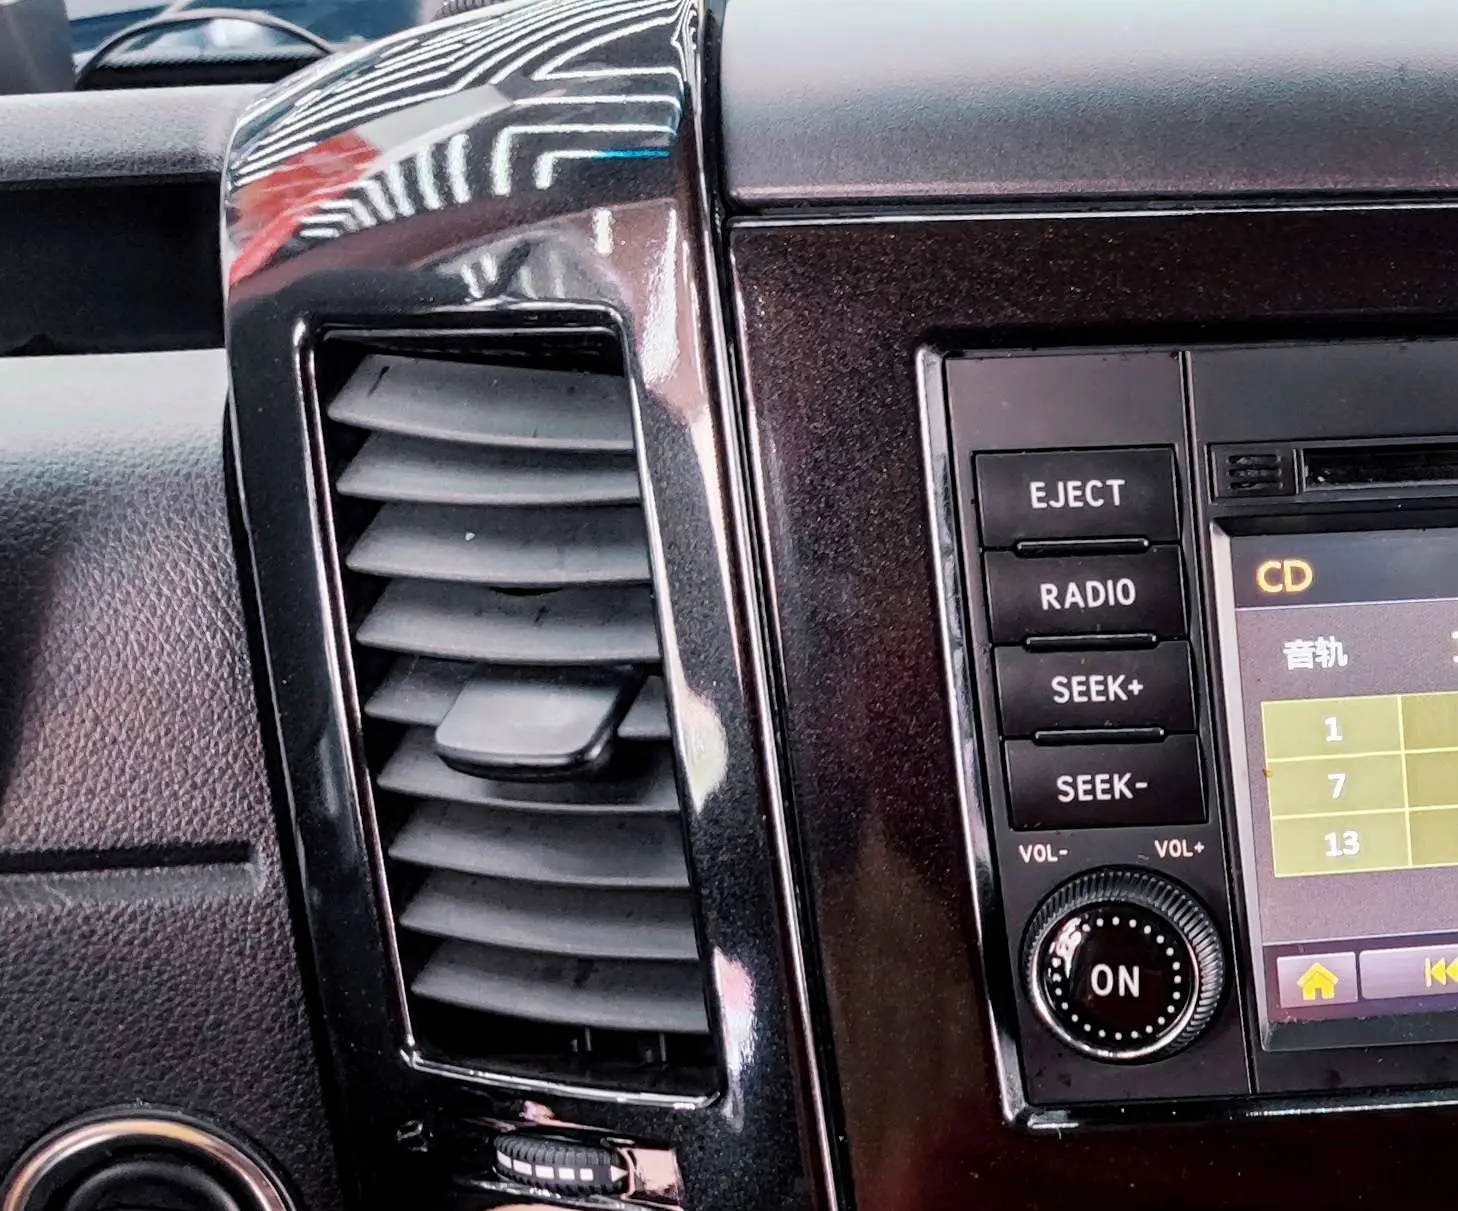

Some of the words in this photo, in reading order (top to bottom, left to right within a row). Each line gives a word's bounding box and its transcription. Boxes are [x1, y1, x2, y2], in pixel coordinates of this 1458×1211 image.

[1030, 479, 1125, 509] EJECT
[1256, 559, 1312, 594] CD
[1041, 579, 1136, 609] RADIO
[1283, 638, 1348, 670] 音轨
[1052, 675, 1144, 701] SEEK+
[1325, 718, 1341, 741] 1
[1056, 773, 1148, 802] SEEK-
[1328, 774, 1346, 798] 7
[1019, 844, 1068, 863] VOL-
[1154, 839, 1205, 859] VOL+
[1324, 831, 1360, 857] 13
[1091, 966, 1140, 998] ON
